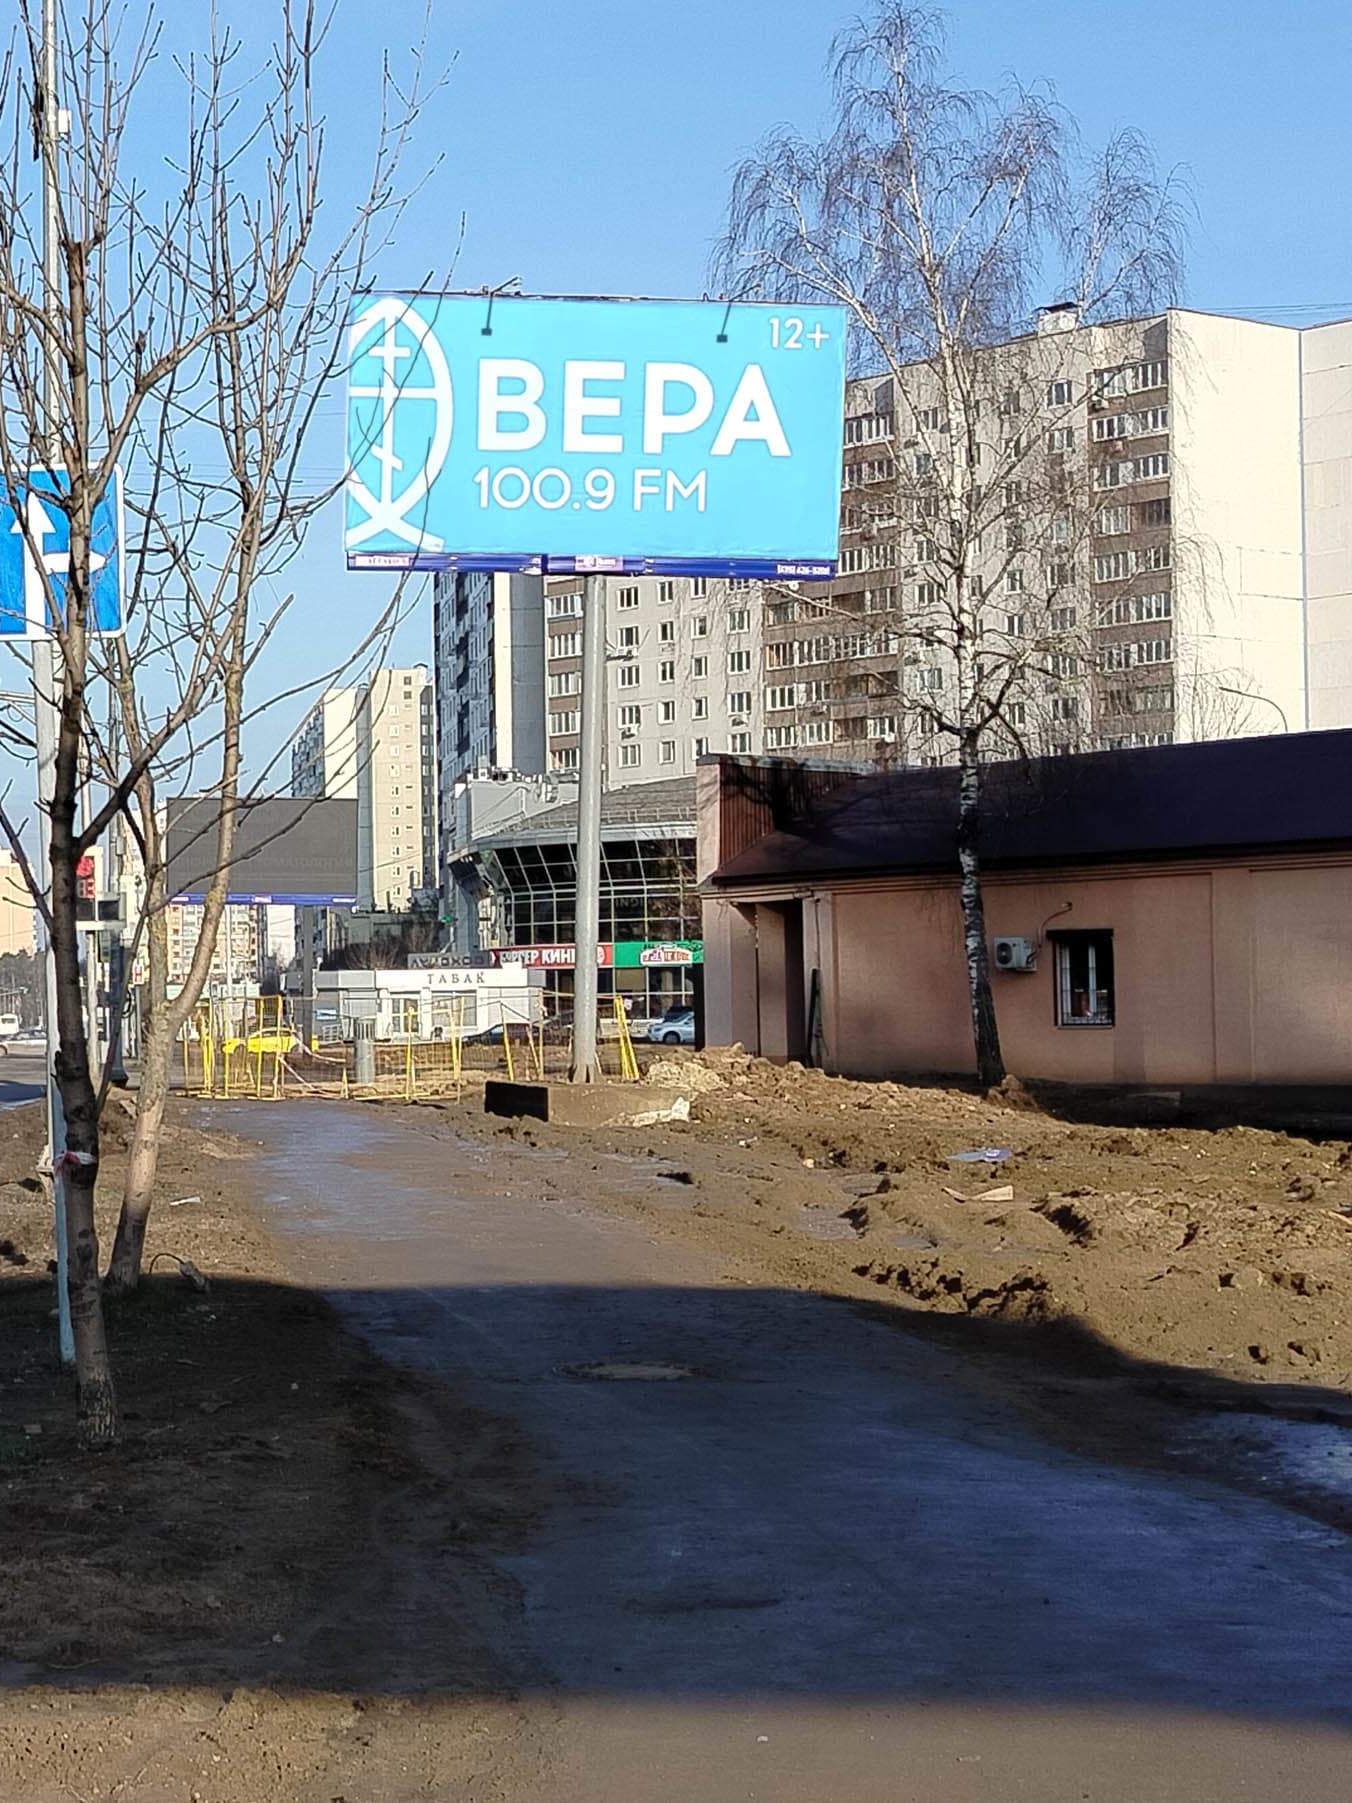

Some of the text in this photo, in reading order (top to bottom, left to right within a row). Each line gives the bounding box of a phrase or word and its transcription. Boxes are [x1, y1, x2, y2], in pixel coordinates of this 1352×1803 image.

[769, 317, 830, 349] 12+
[477, 358, 791, 456] ВЕРА
[474, 466, 706, 511] 100.9 FM
[427, 971, 485, 984] ТАБАК
